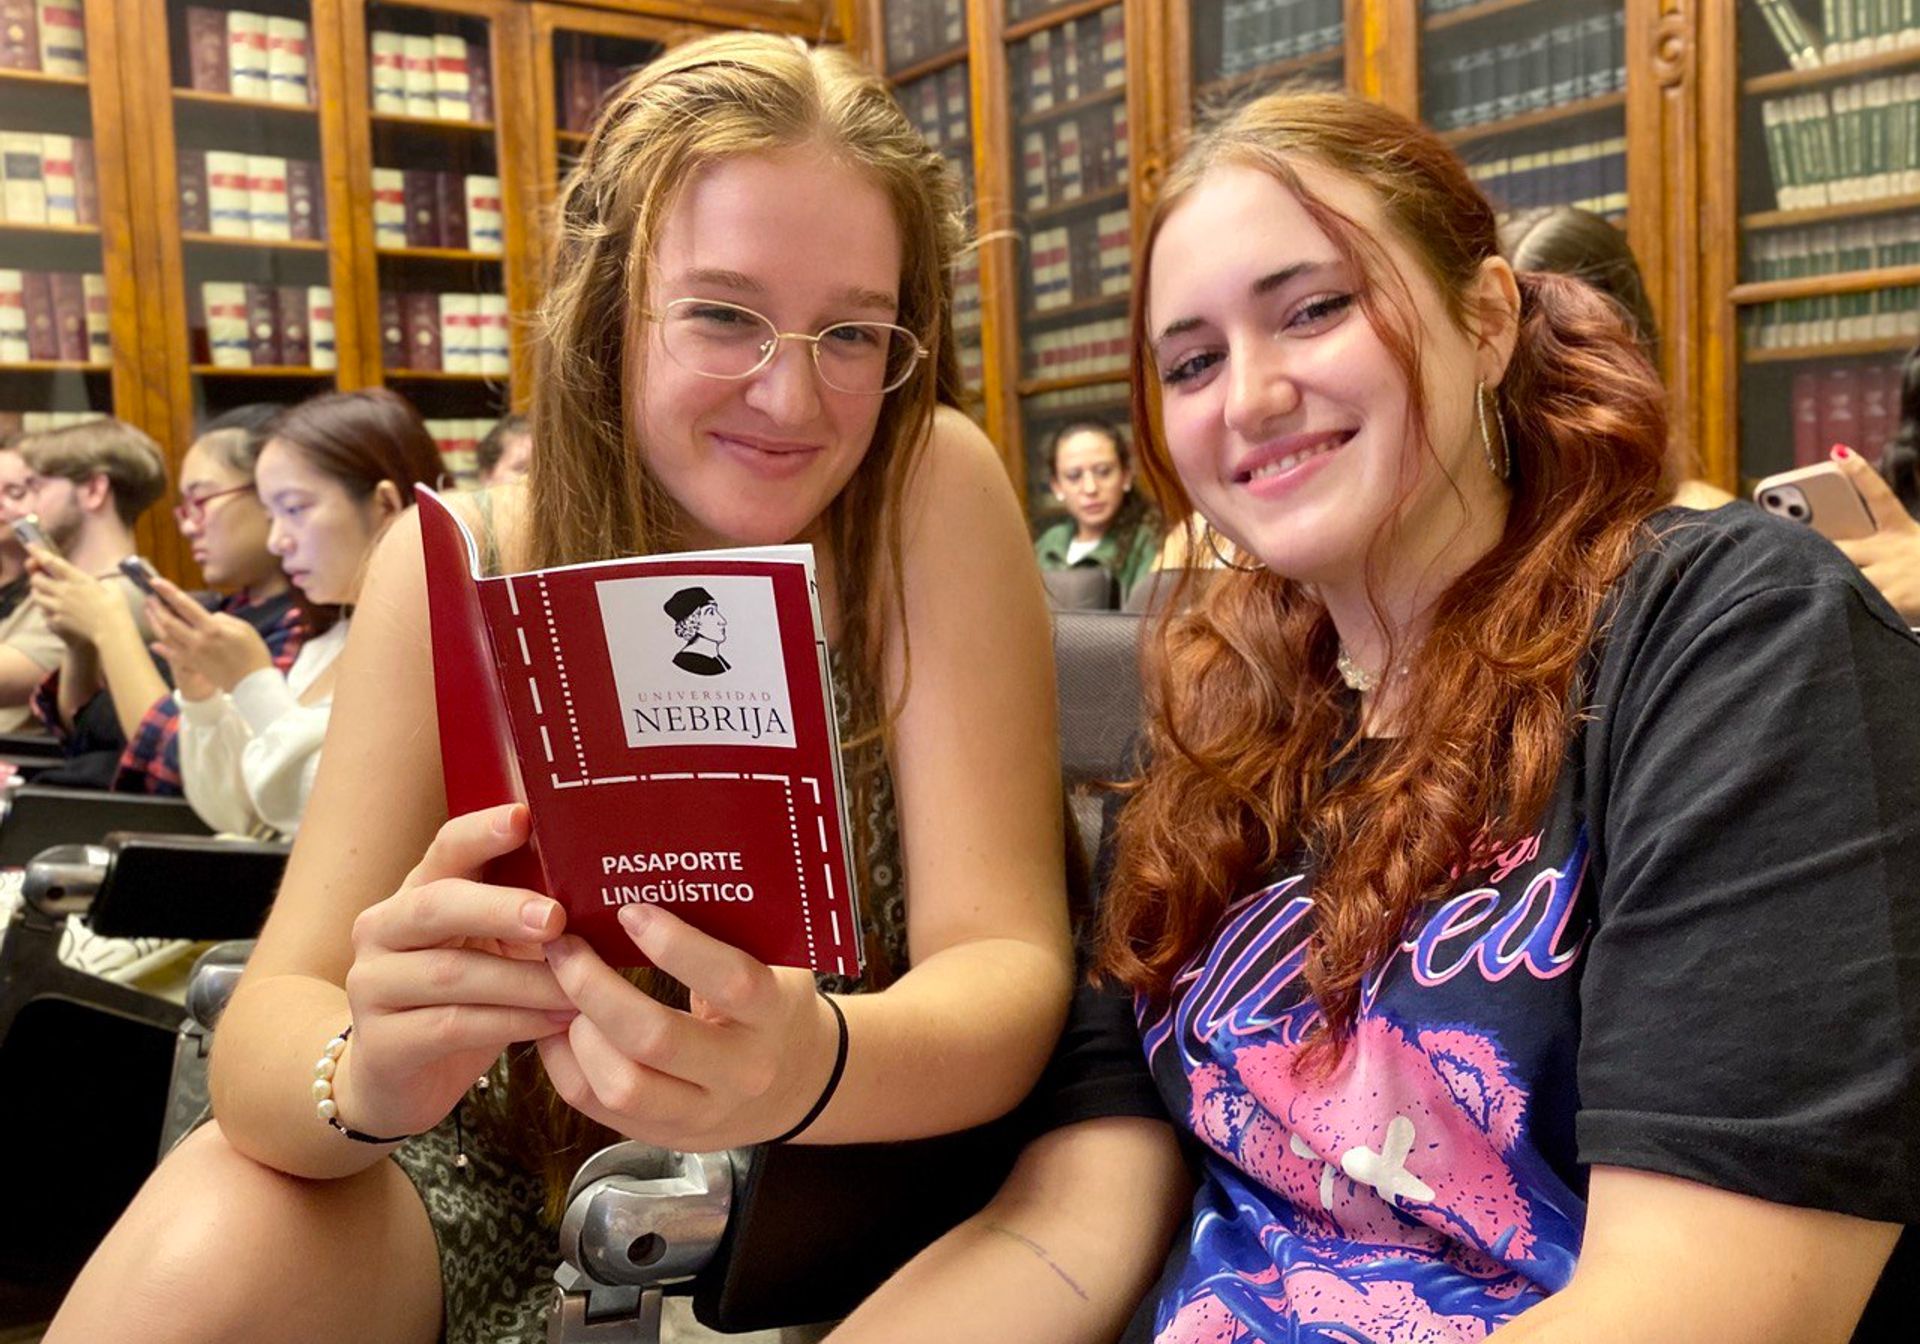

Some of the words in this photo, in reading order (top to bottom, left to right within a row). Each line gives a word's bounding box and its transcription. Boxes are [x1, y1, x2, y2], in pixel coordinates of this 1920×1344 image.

[637, 690, 772, 703] UNIVERSIDAD
[632, 705, 788, 739] NEBRIJA
[601, 851, 744, 875] PASAPORTE
[601, 879, 755, 906] LINGÜÍSTICO
